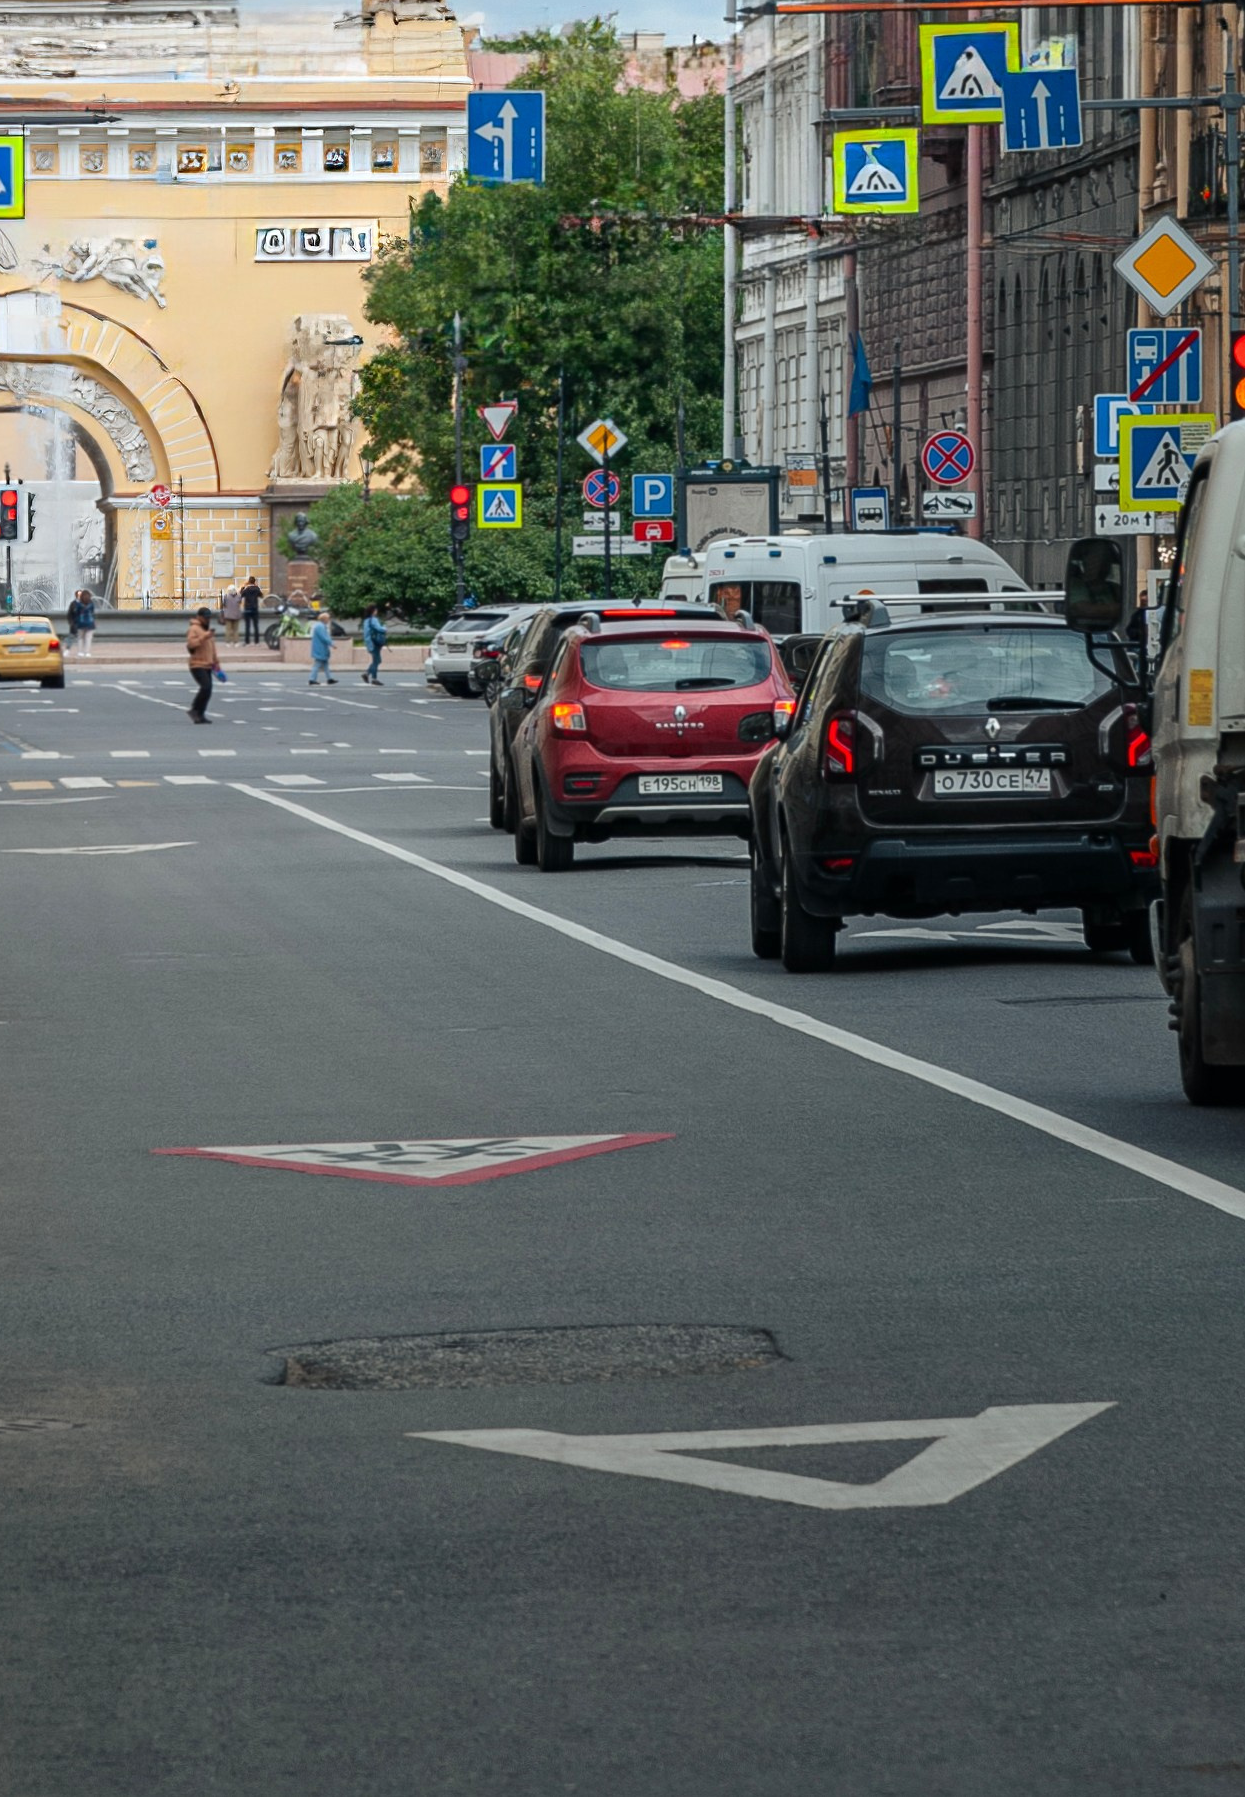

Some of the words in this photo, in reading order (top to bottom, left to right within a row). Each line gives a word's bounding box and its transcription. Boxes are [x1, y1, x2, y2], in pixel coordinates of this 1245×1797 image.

[644, 480, 665, 511] P
[920, 752, 1066, 764] DUSTER
[698, 775, 717, 787] 198
[1025, 768, 1043, 783] 47
